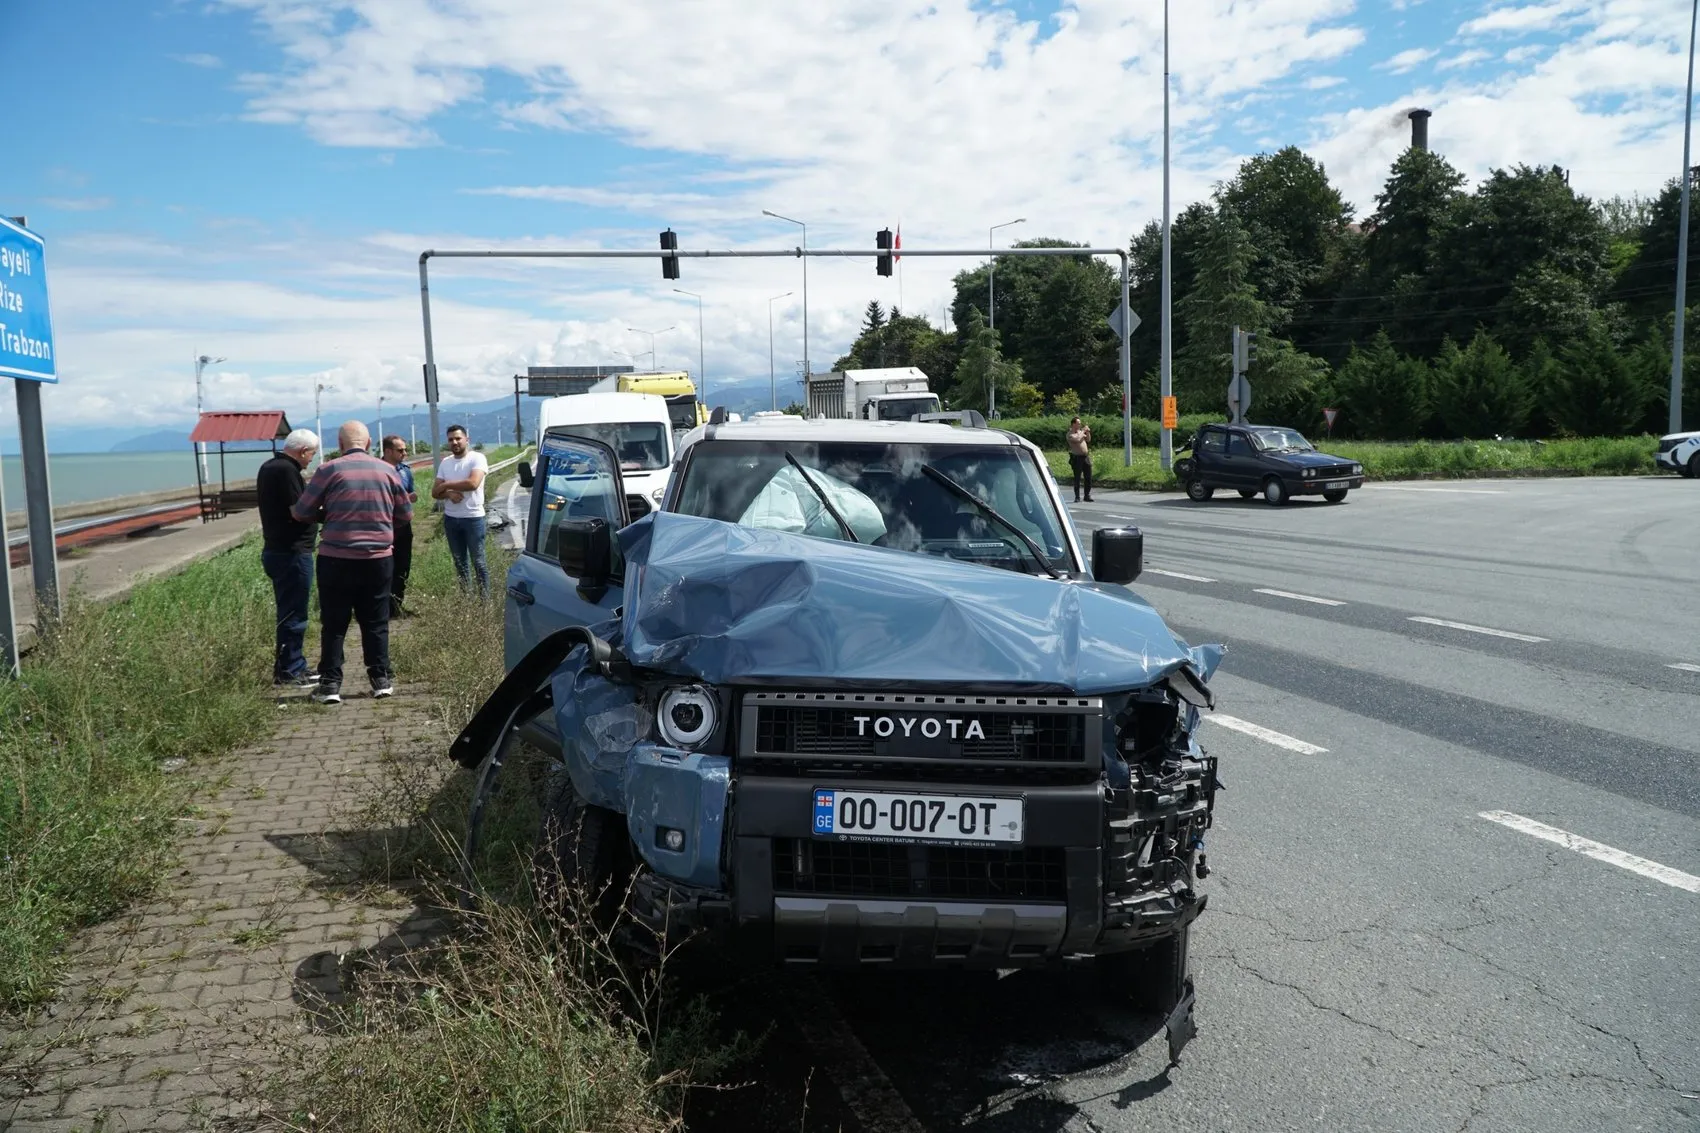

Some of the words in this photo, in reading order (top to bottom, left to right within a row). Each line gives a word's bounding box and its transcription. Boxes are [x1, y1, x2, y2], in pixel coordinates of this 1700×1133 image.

[0, 247, 30, 276] ayeli
[0, 323, 51, 360] Trabzon
[853, 716, 986, 740] TOYOTA
[816, 814, 832, 829] GE
